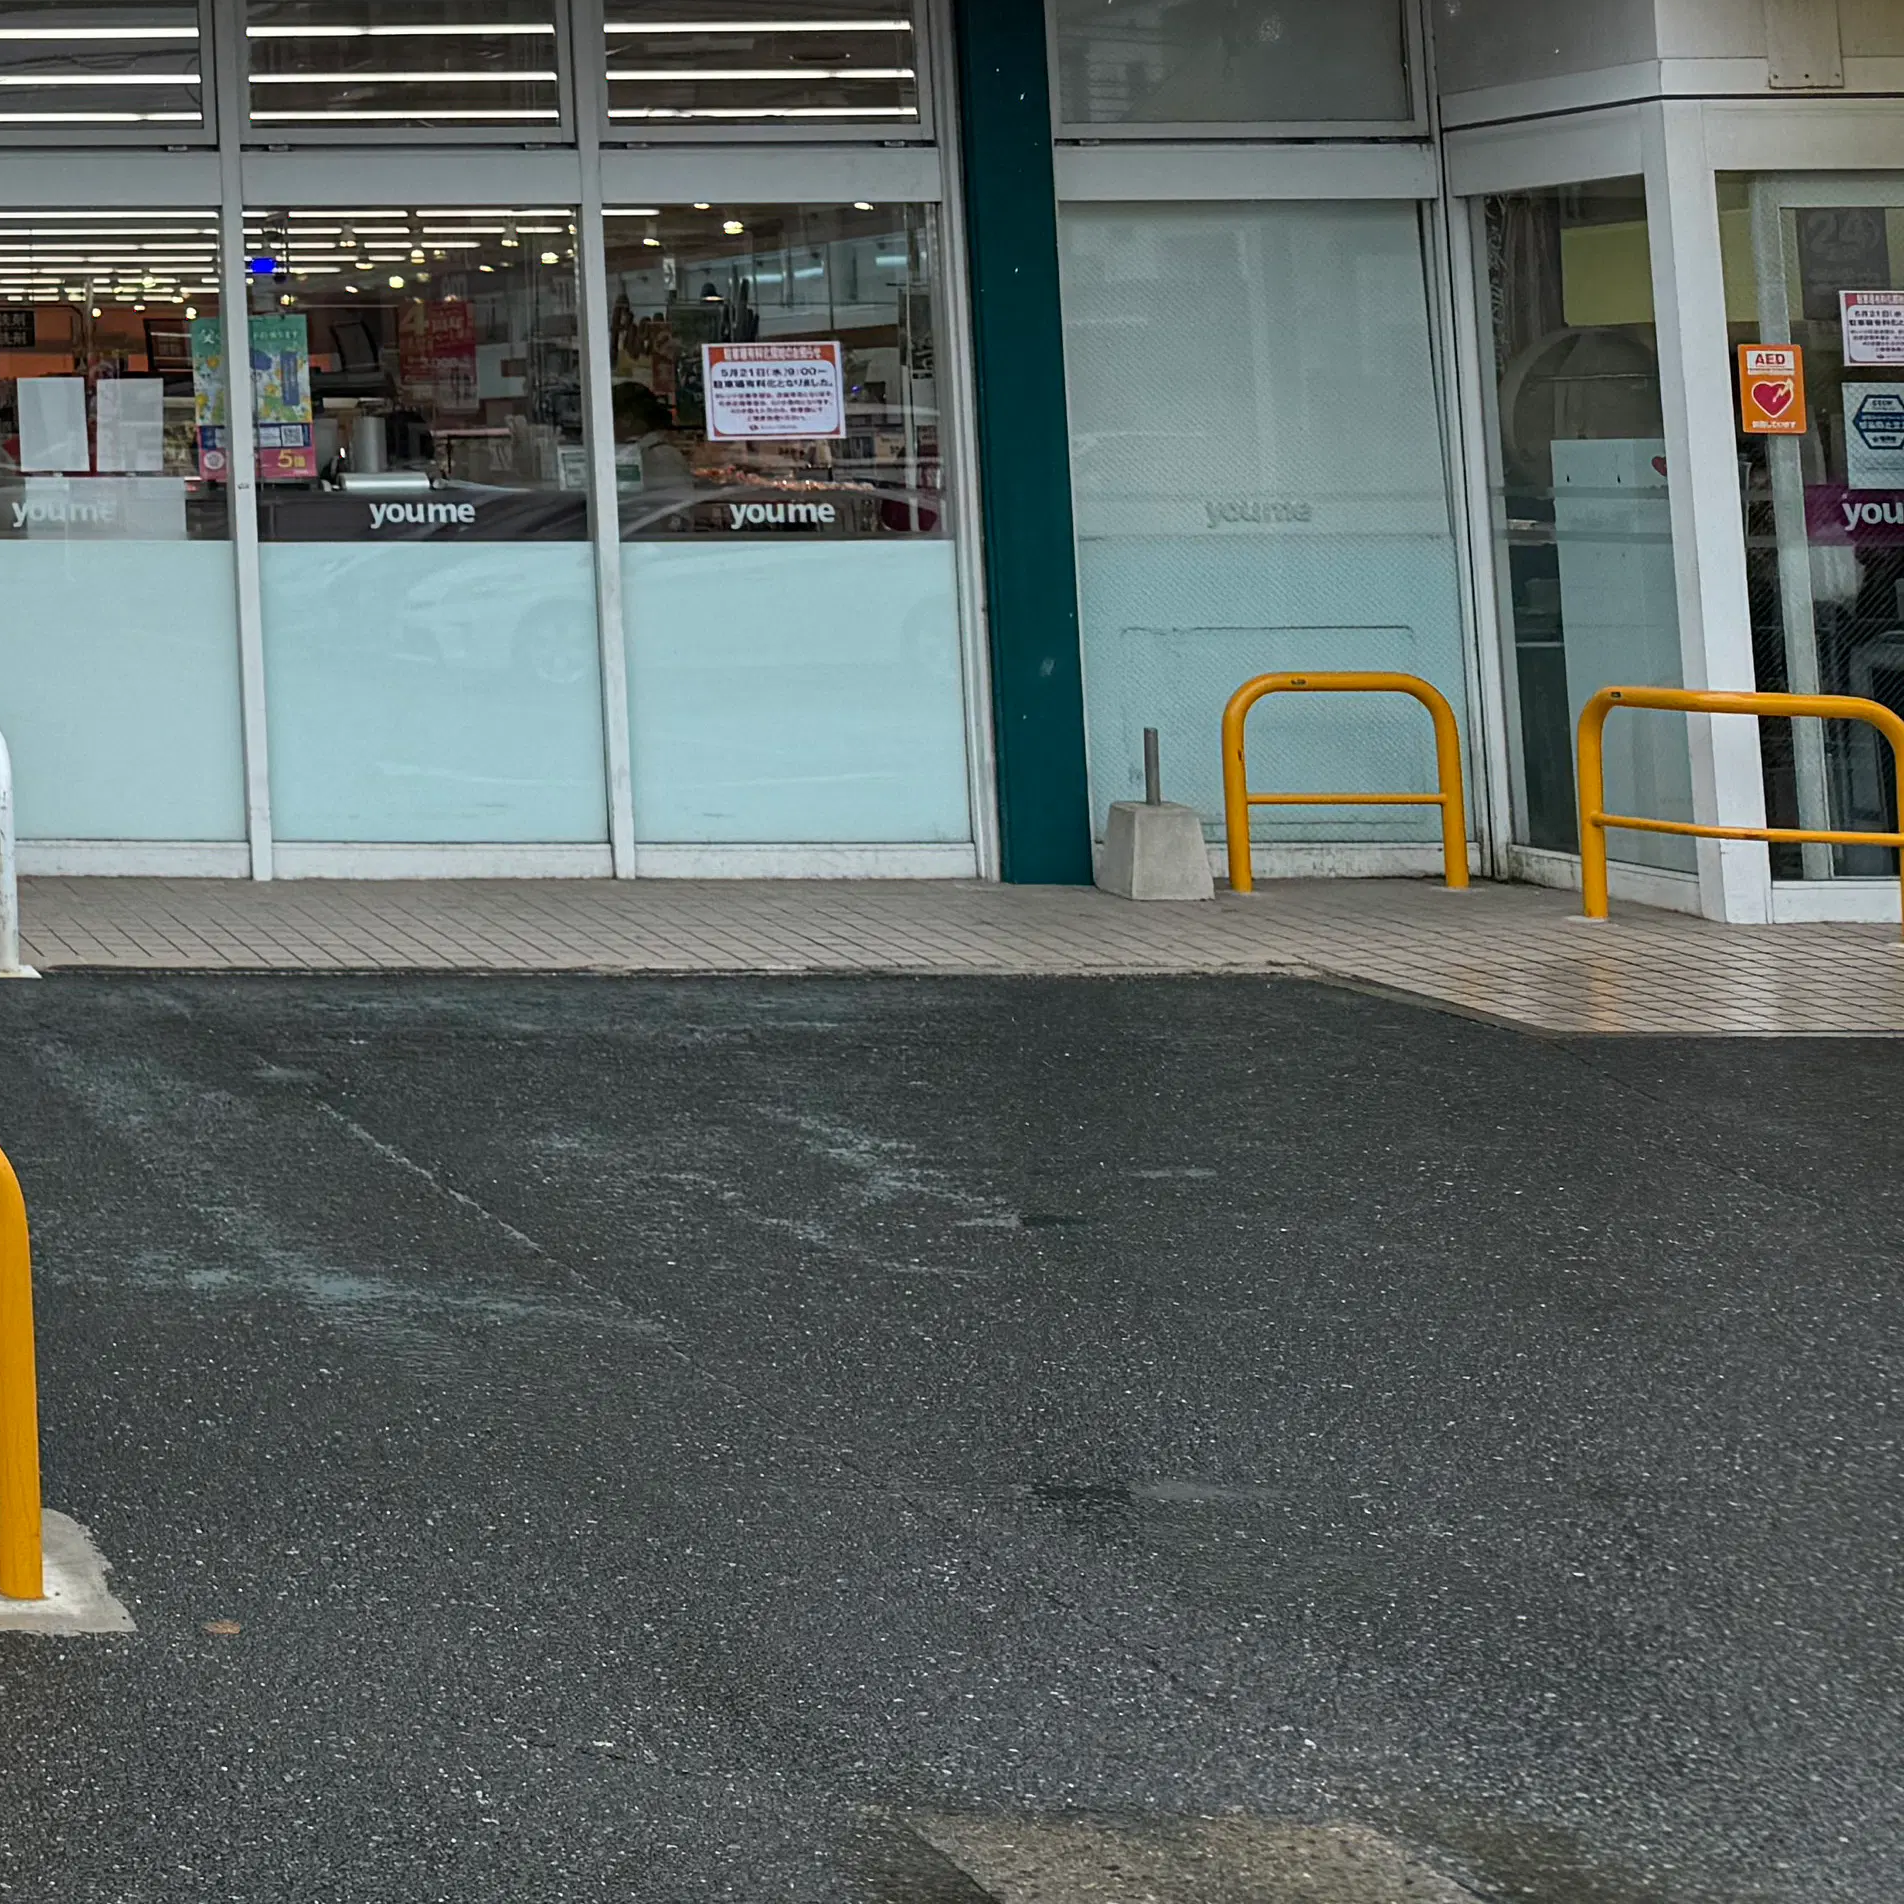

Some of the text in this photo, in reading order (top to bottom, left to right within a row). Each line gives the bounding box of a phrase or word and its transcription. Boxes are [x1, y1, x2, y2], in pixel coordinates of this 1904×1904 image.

[1754, 353, 1786, 365] AED
[12, 500, 117, 528] youme
[369, 500, 476, 528] youme
[729, 501, 836, 529] youme
[1205, 497, 1313, 527] youme
[1842, 502, 1904, 532] you
